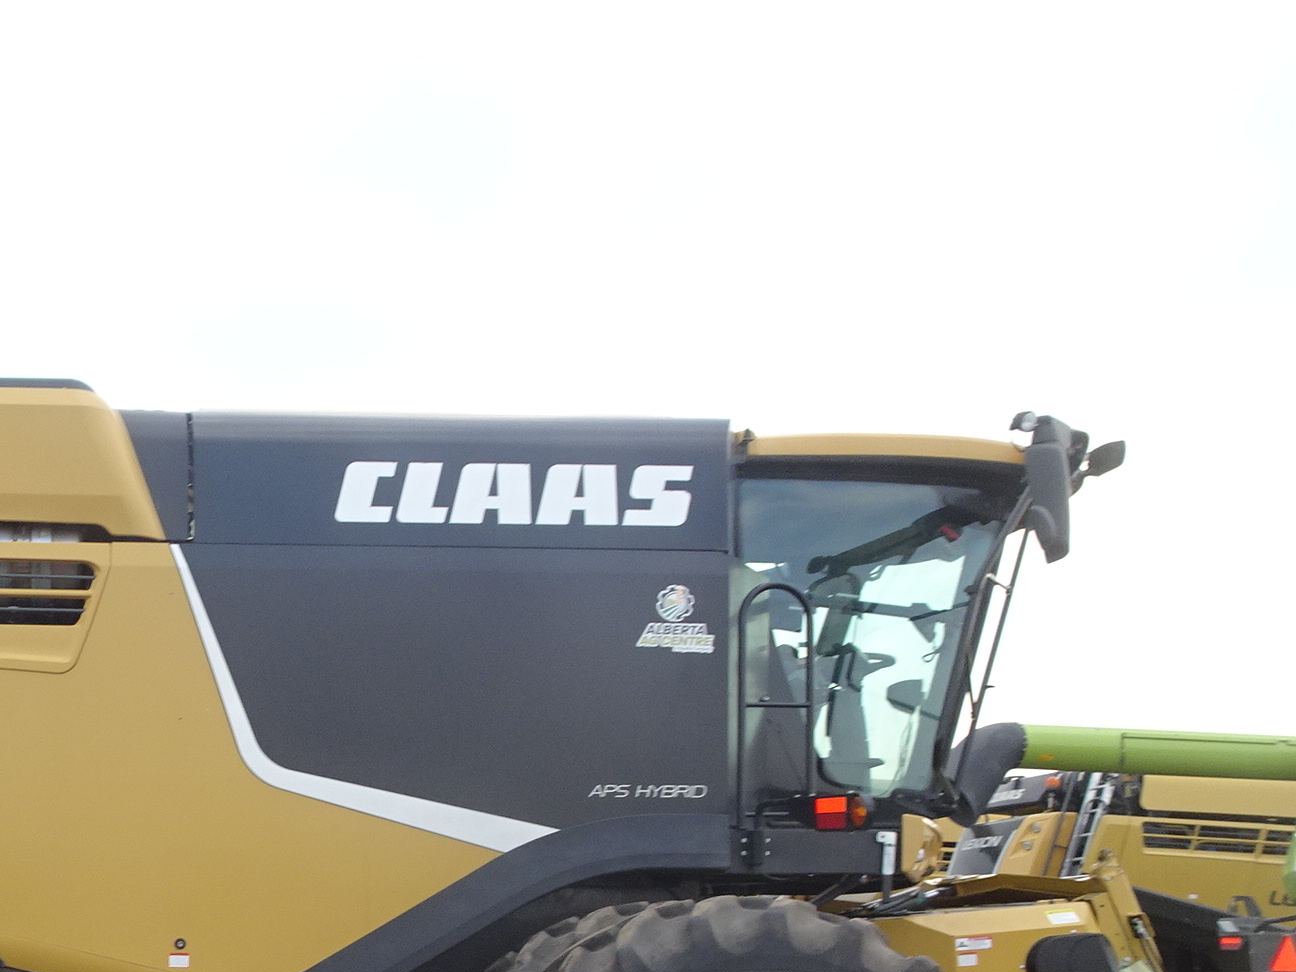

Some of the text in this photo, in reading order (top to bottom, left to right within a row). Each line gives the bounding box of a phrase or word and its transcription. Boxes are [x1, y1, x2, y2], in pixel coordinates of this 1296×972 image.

[334, 461, 694, 526] CLAAS
[646, 624, 705, 634] ALBERTA
[587, 784, 708, 799] APS HYBRID
